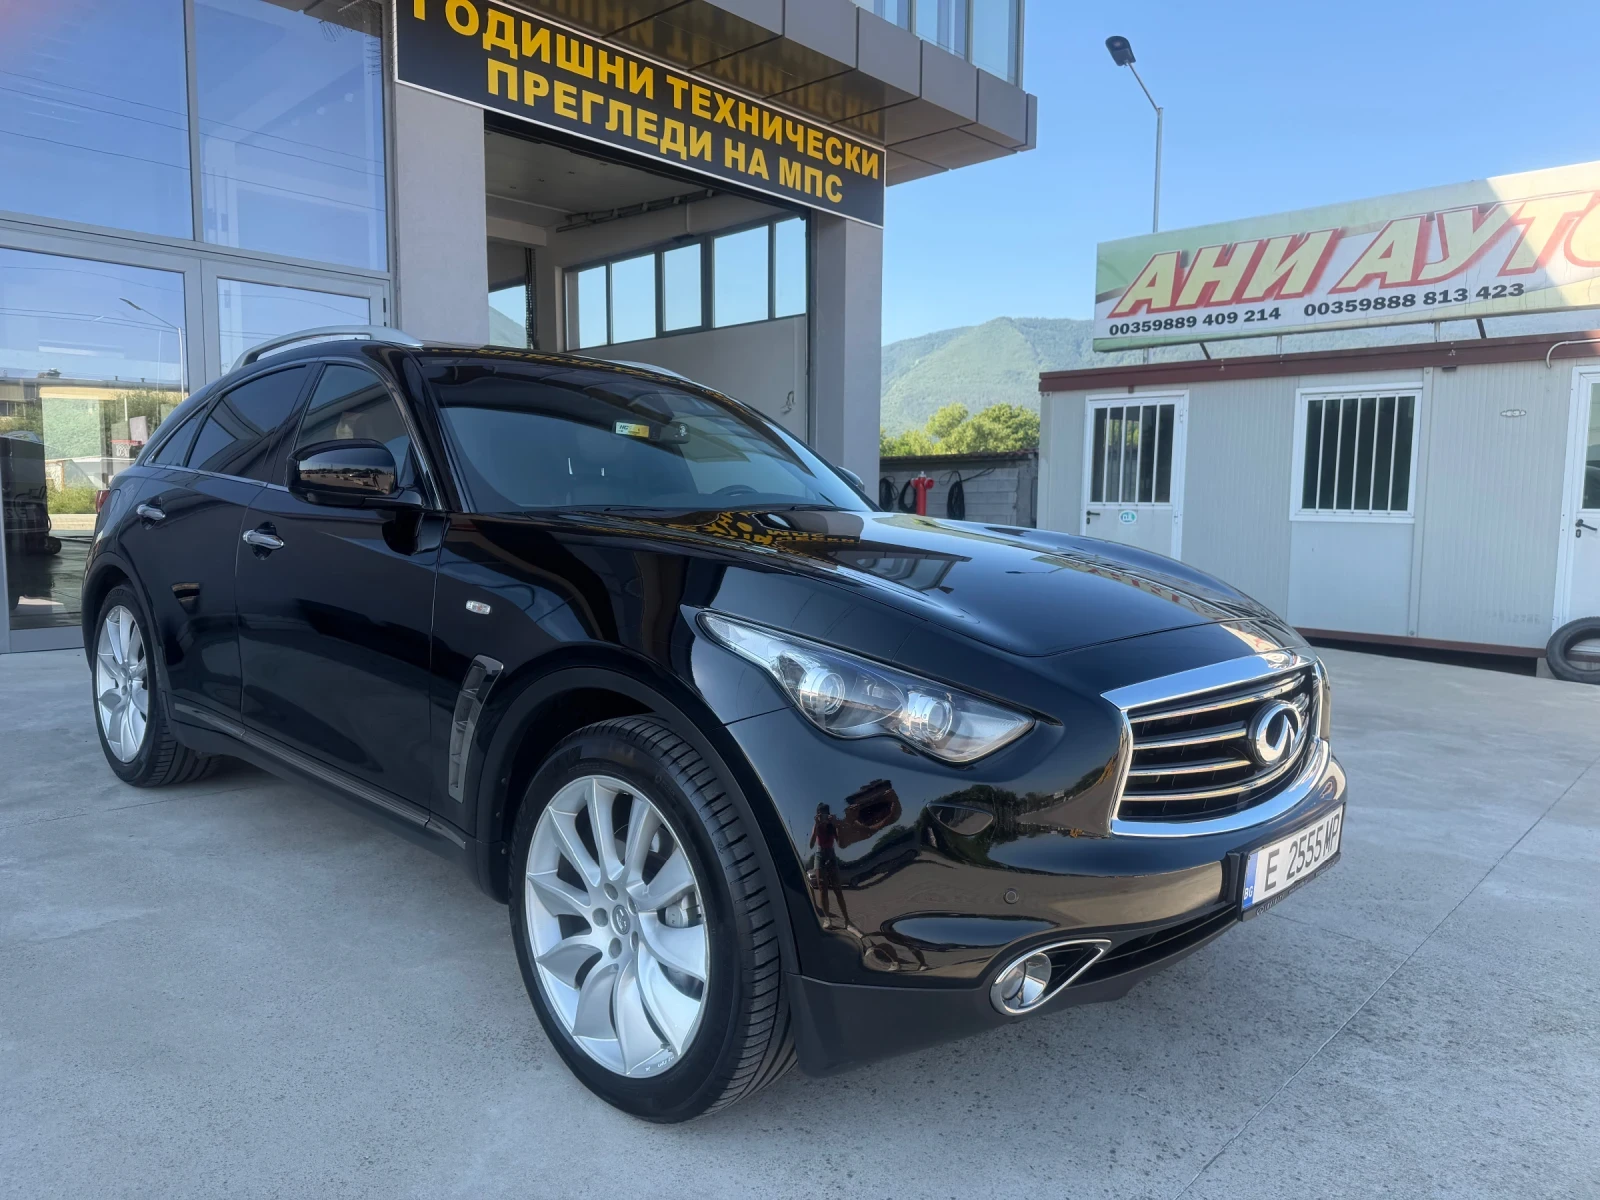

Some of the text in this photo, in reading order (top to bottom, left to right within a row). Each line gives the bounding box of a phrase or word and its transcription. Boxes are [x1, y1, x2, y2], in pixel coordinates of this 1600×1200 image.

[487, 59, 843, 203] ПРЕГЛЕДИ НА МПС
[667, 75, 880, 180] ТЕХНИЧЕСКИ
[1108, 227, 1344, 318] АНИ
[1109, 283, 1524, 336] 00359889 409 214 00359888 813 423
[1243, 885, 1254, 899] BG
[1264, 848, 1280, 892] E
[1287, 825, 1323, 880] 2555
